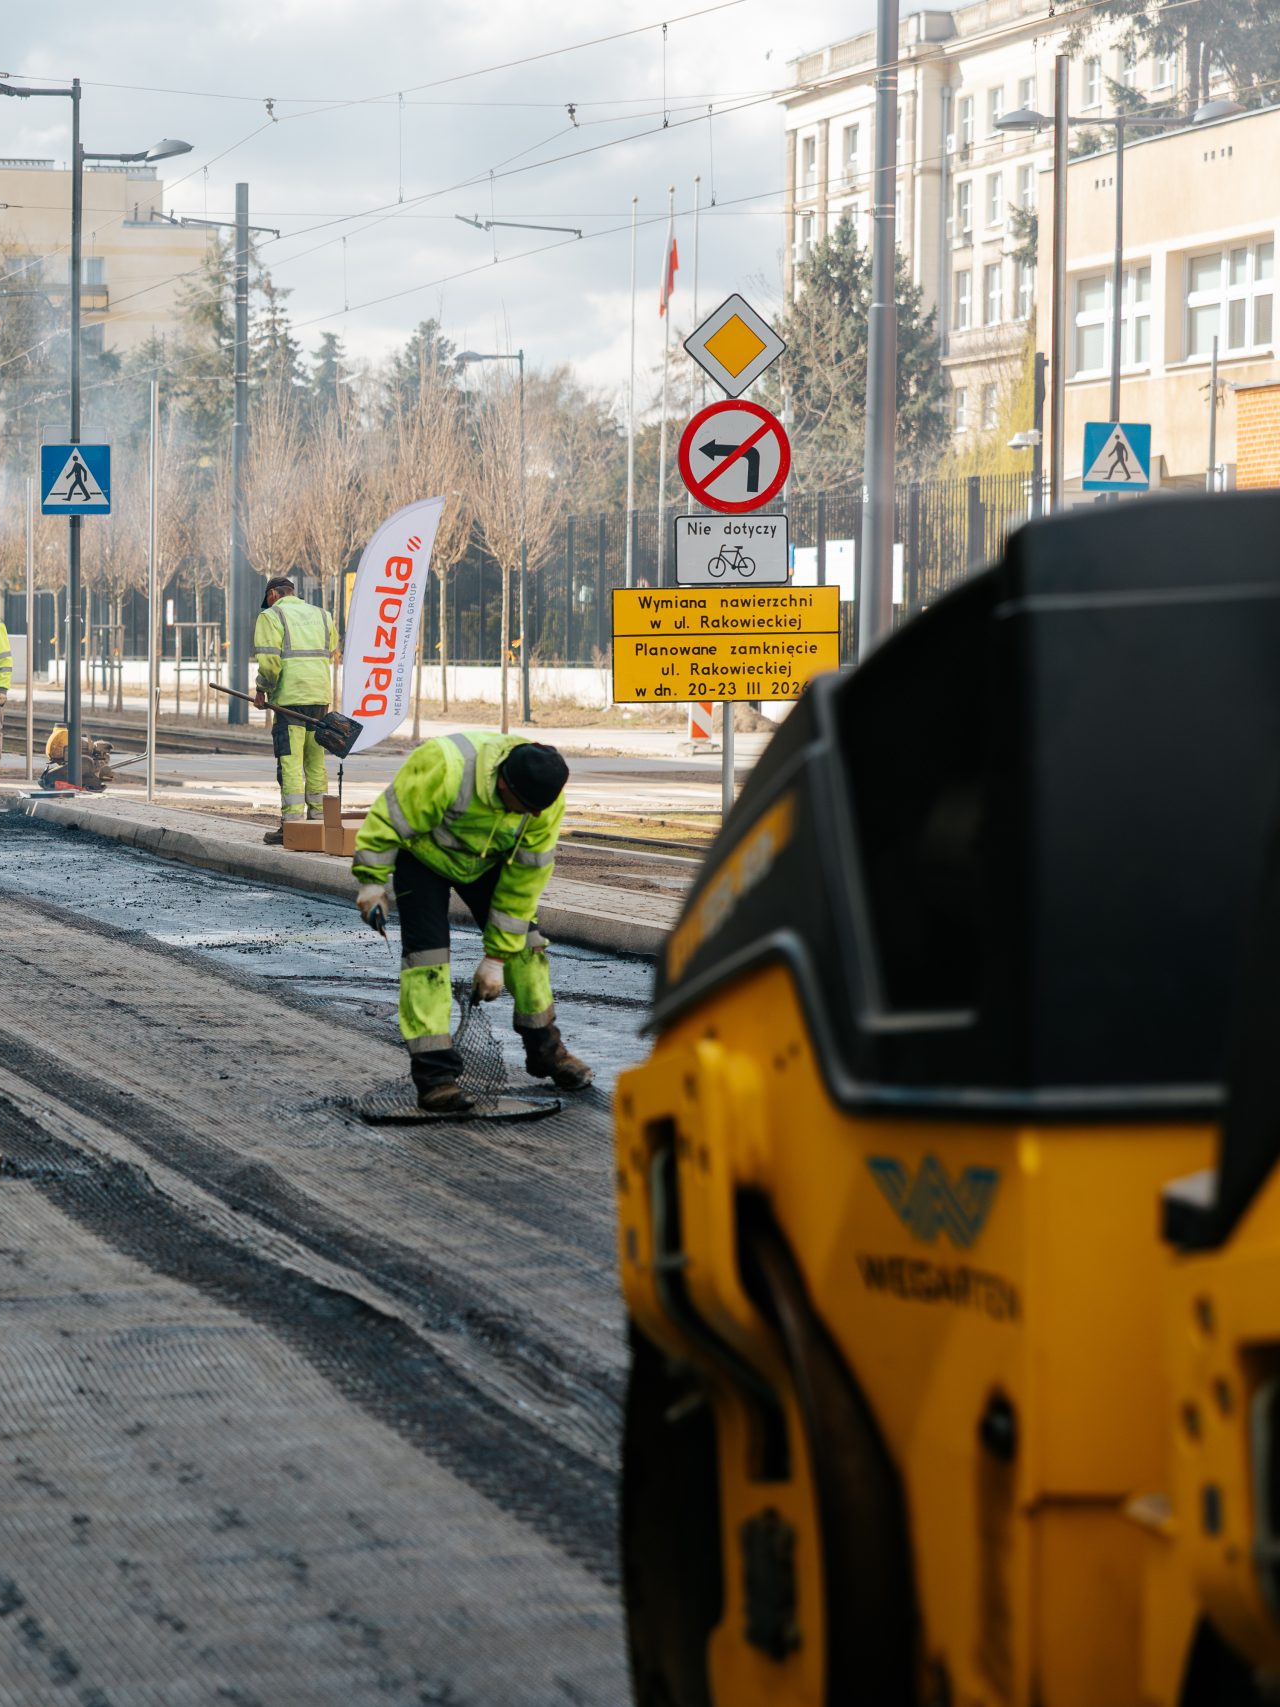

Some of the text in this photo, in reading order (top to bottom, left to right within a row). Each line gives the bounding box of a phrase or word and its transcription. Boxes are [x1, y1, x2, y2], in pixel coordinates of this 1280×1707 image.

[687, 522, 777, 538] Nie dotyczy
[407, 583, 417, 615] GROUP
[638, 594, 813, 613] Wymiana nawierzchni
[650, 615, 802, 631] w ul. Rakowieckiej
[351, 556, 413, 717] balzola
[635, 642, 818, 657] Planowane zamknięcie
[397, 663, 405, 674] OF
[661, 662, 792, 677] ul. Rakowieckiej
[394, 678, 403, 716] MEMBER
[635, 687, 647, 697] w
[654, 684, 677, 697] dn.
[688, 682, 737, 695] 20-23
[746, 682, 760, 695] III
